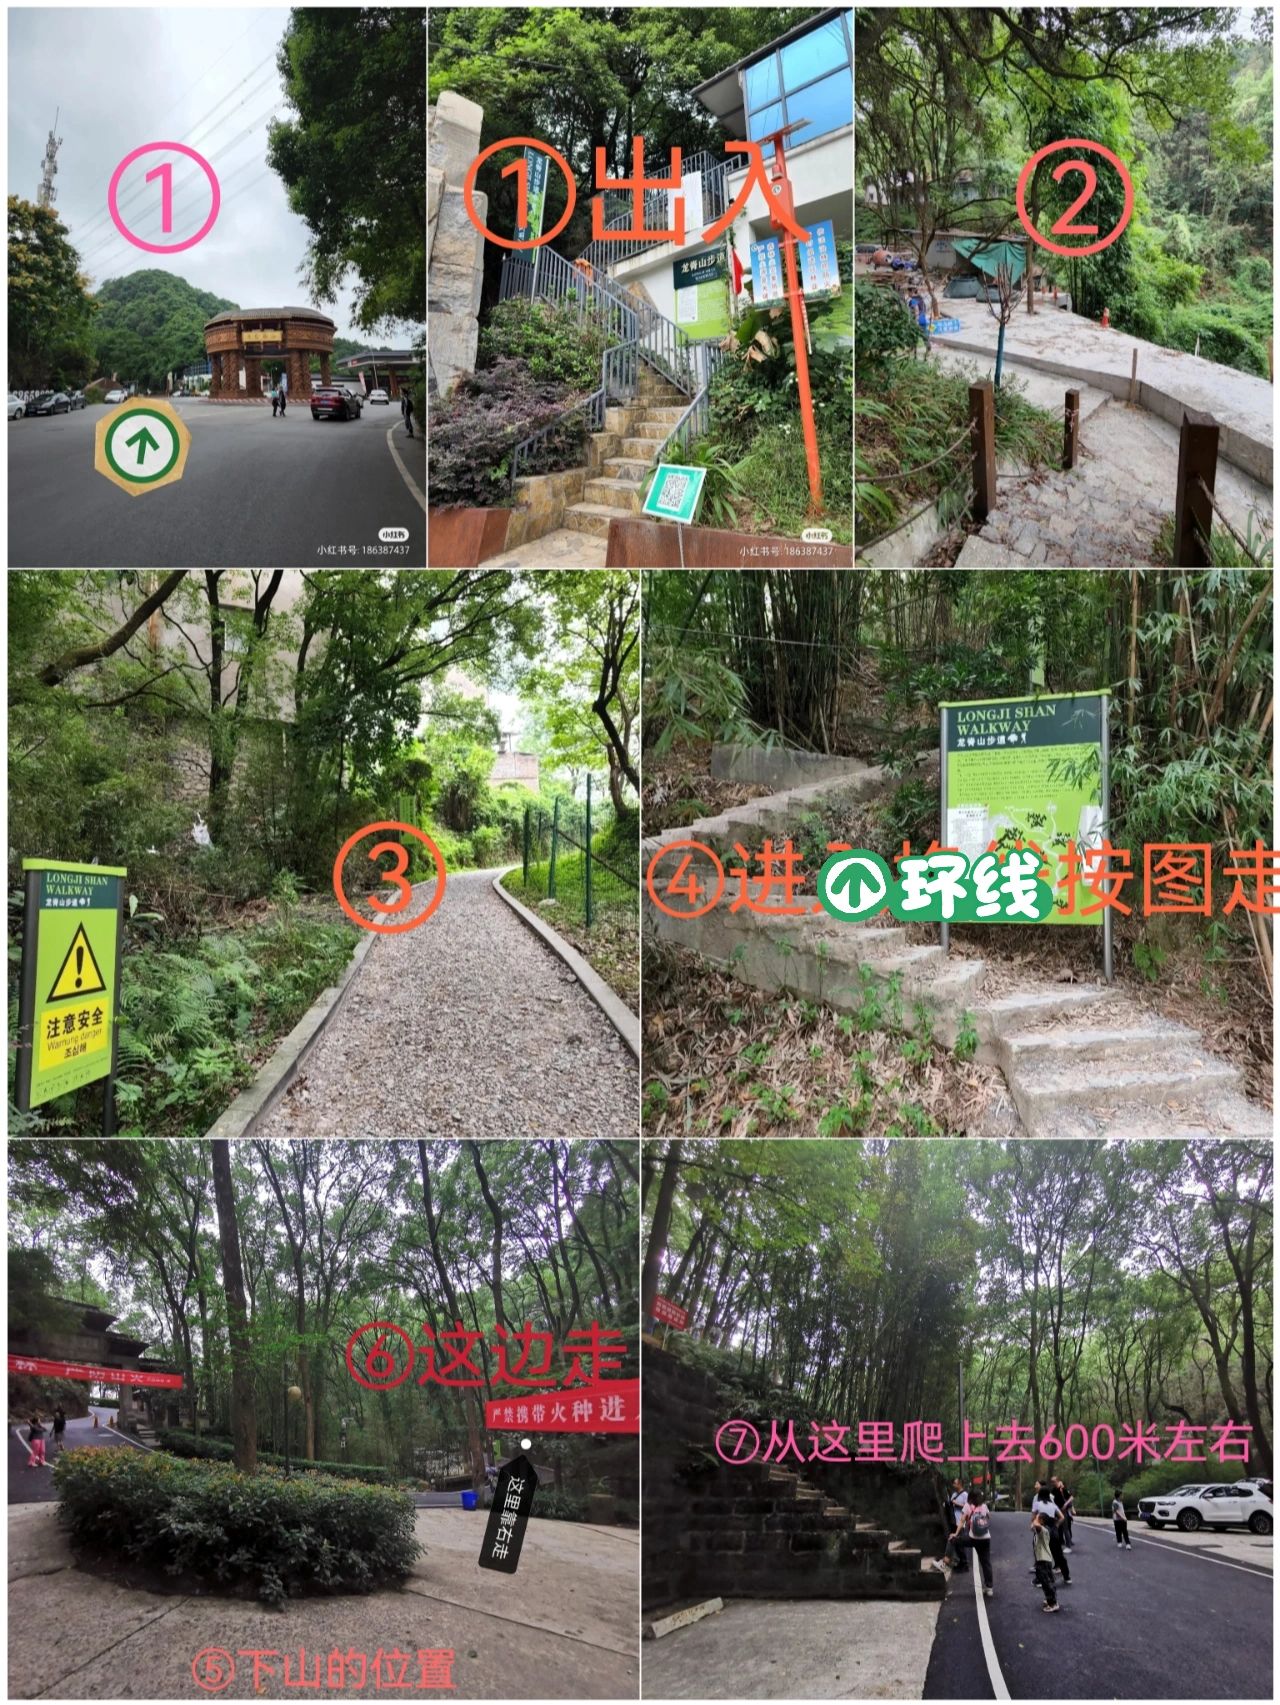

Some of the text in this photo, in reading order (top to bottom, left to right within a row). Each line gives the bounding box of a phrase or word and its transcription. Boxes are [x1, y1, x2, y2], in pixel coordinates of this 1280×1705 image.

[957, 704, 1057, 723] LONGJI SHAN
[957, 719, 1031, 736] WALKWAY
[46, 872, 108, 886] LONGJI SHAN
[46, 884, 93, 896] WALKWAY
[47, 1007, 103, 1039] 注意安全
[492, 1395, 640, 1425] 严禁携带火种进
